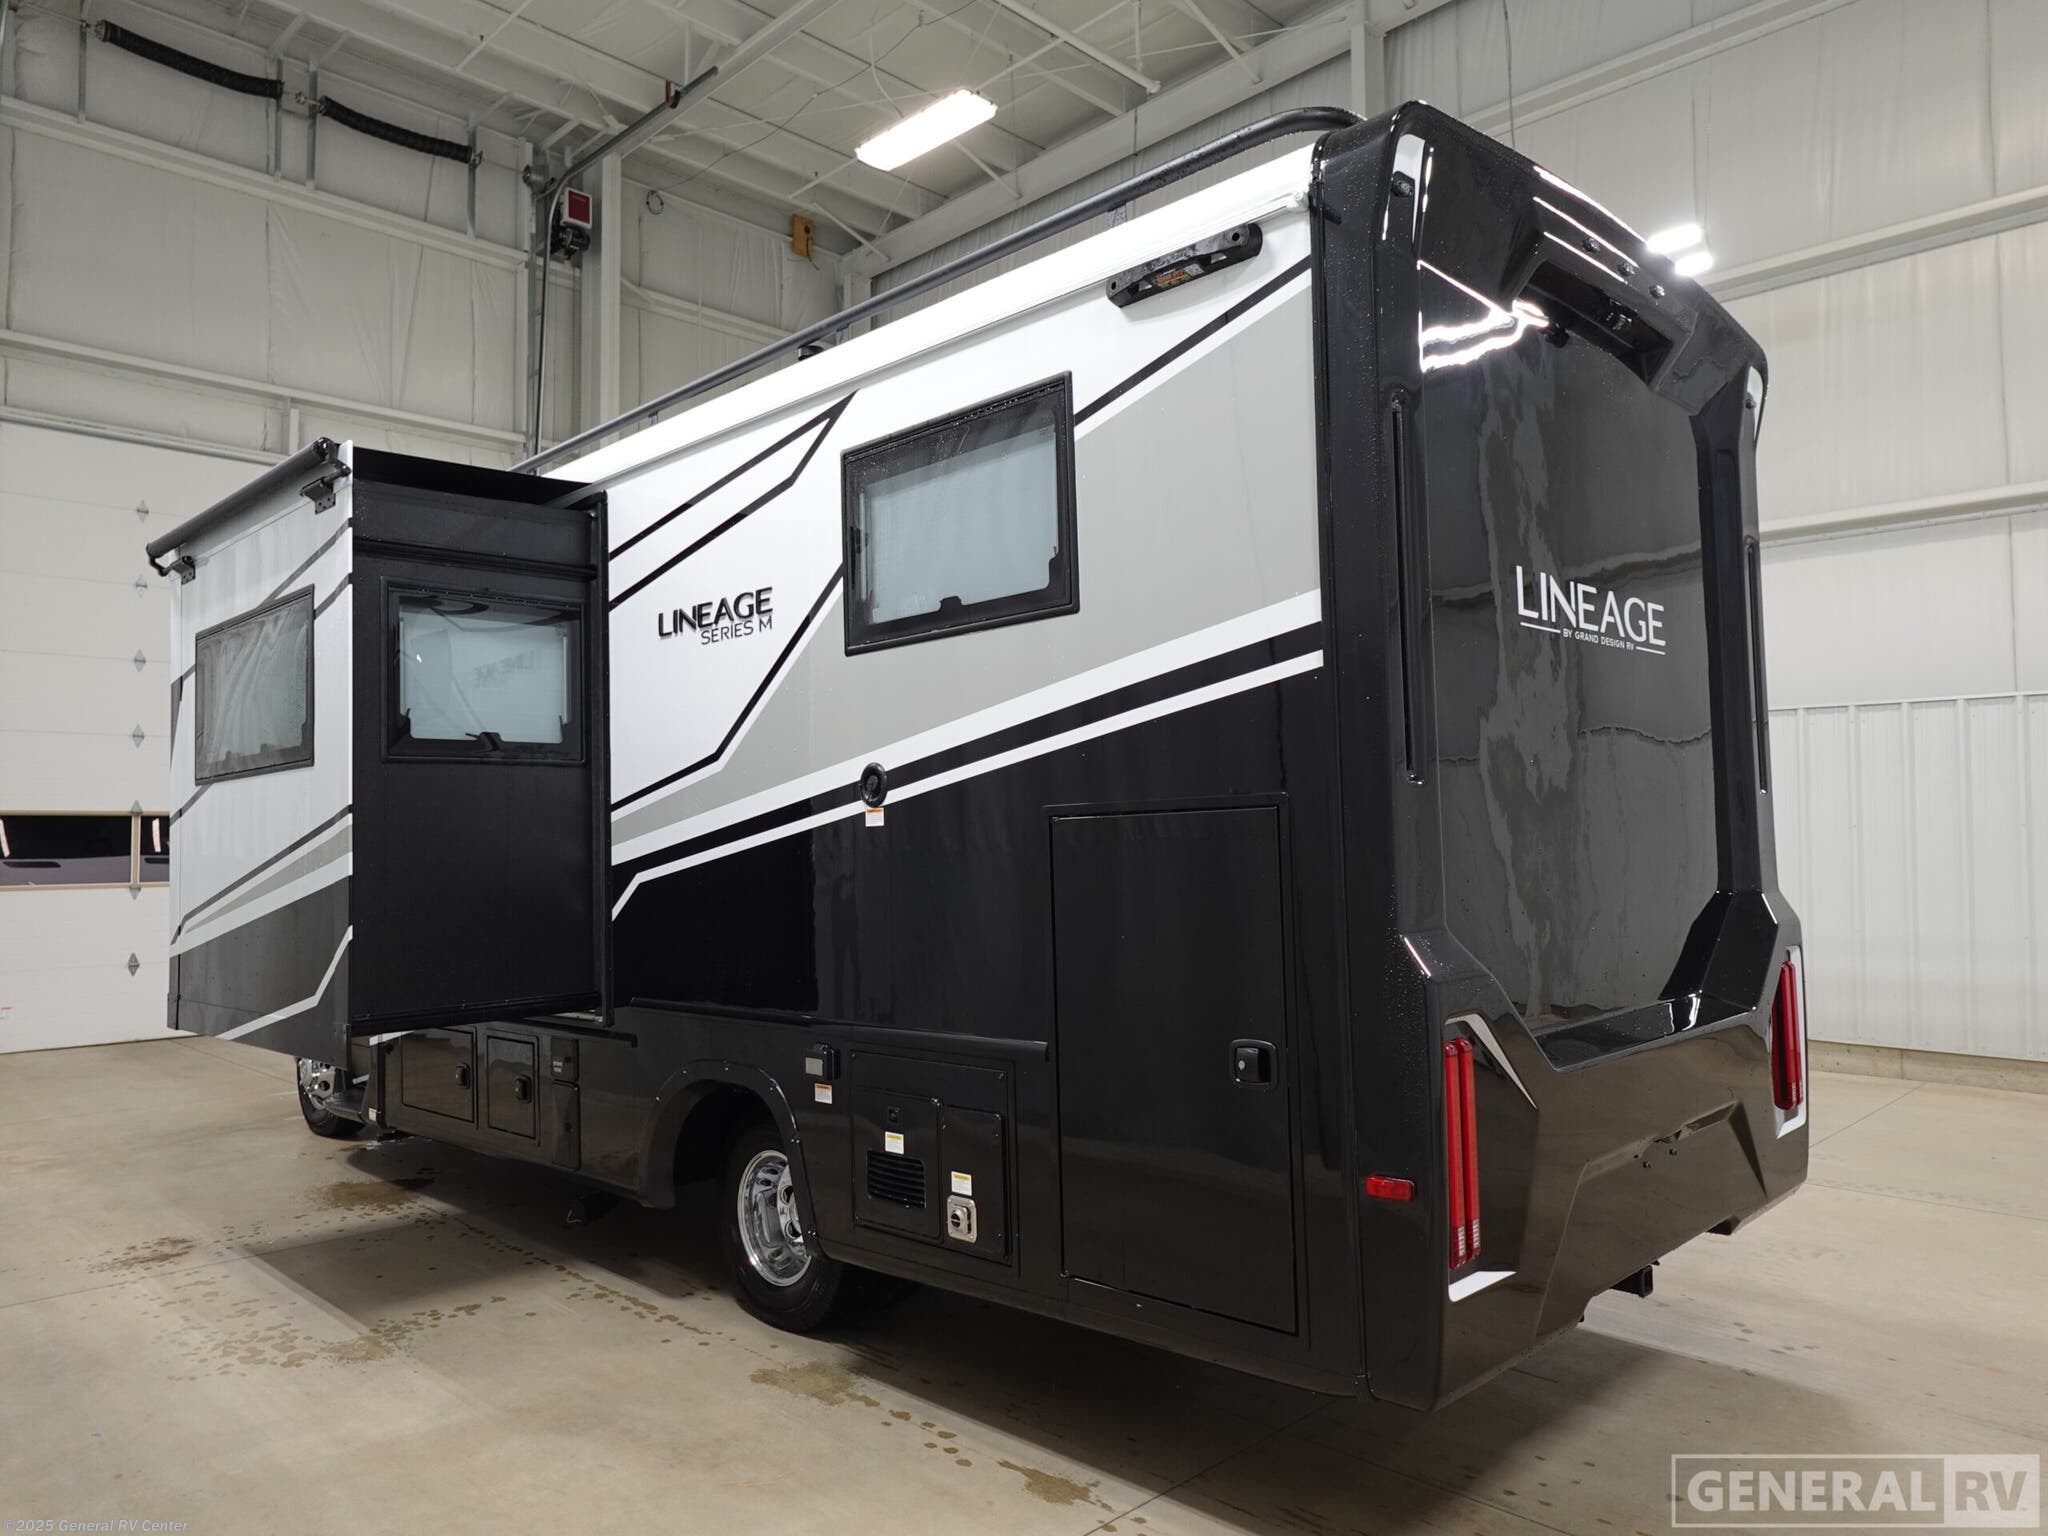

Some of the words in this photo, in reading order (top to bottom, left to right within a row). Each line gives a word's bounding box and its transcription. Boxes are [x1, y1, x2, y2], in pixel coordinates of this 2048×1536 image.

[658, 586, 773, 638] LINEAGE
[1515, 565, 1667, 646] LINEAGE
[700, 620, 754, 645] SERIES
[759, 615, 773, 632] M
[1562, 628, 1573, 638] BY
[1574, 630, 1599, 644] GRAND
[1600, 636, 1625, 649] DESIGN
[1626, 641, 1635, 651] RV
